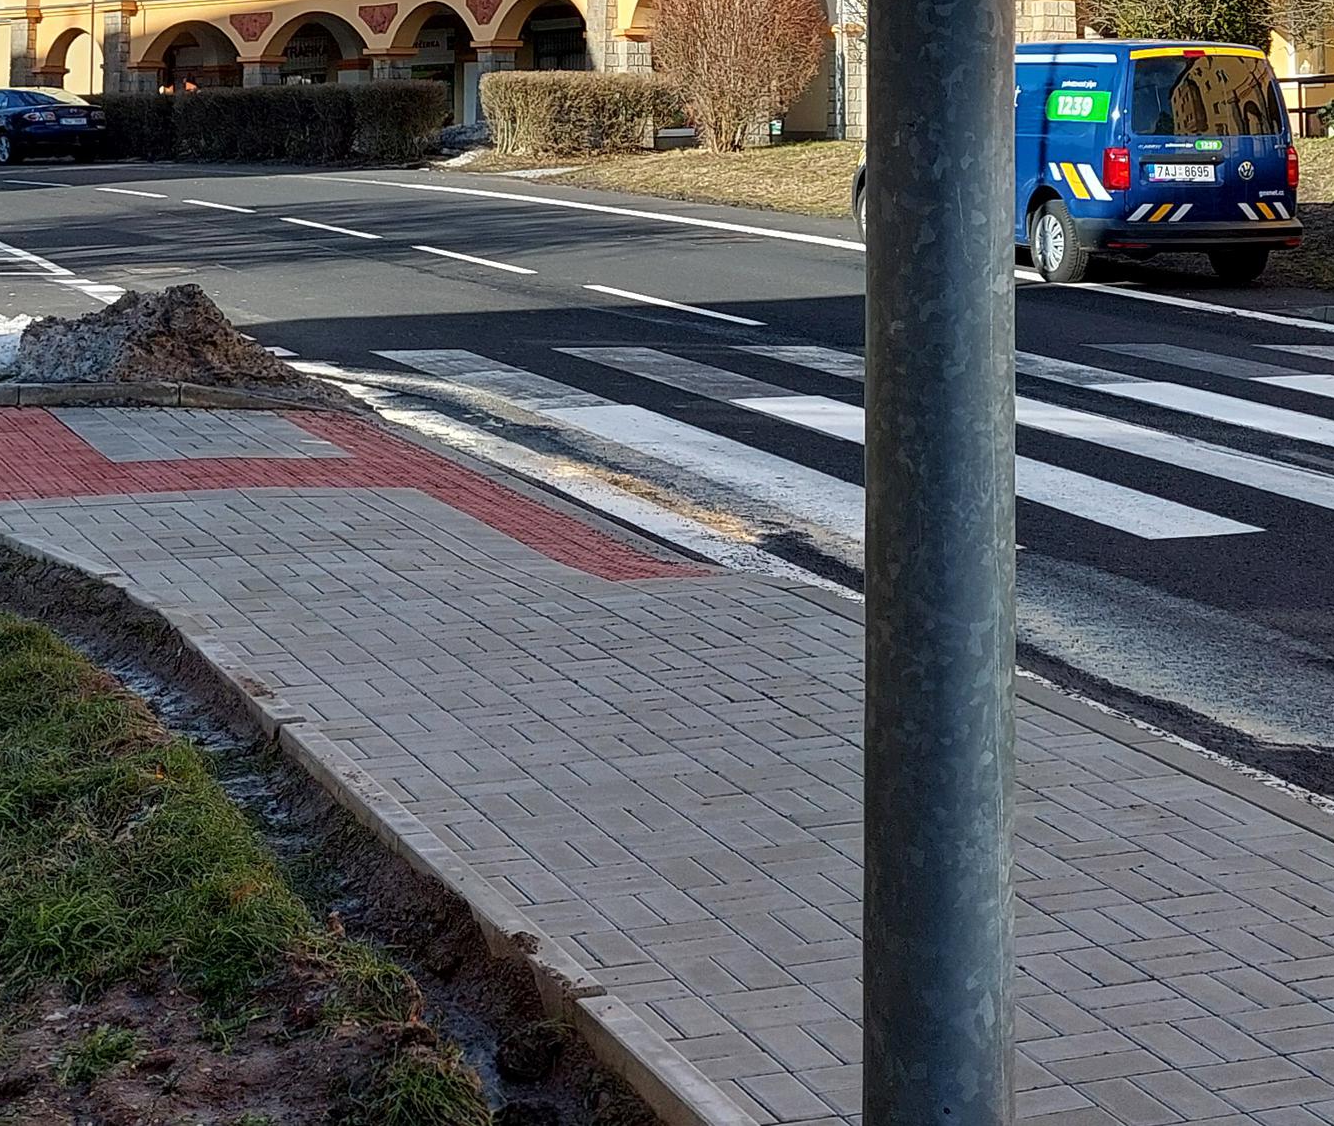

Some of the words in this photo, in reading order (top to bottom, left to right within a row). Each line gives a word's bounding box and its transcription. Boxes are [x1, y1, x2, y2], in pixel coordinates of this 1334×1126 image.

[1057, 95, 1093, 116] 1239
[1157, 165, 1177, 178] 7AJ
[1184, 165, 1210, 178] 8695
